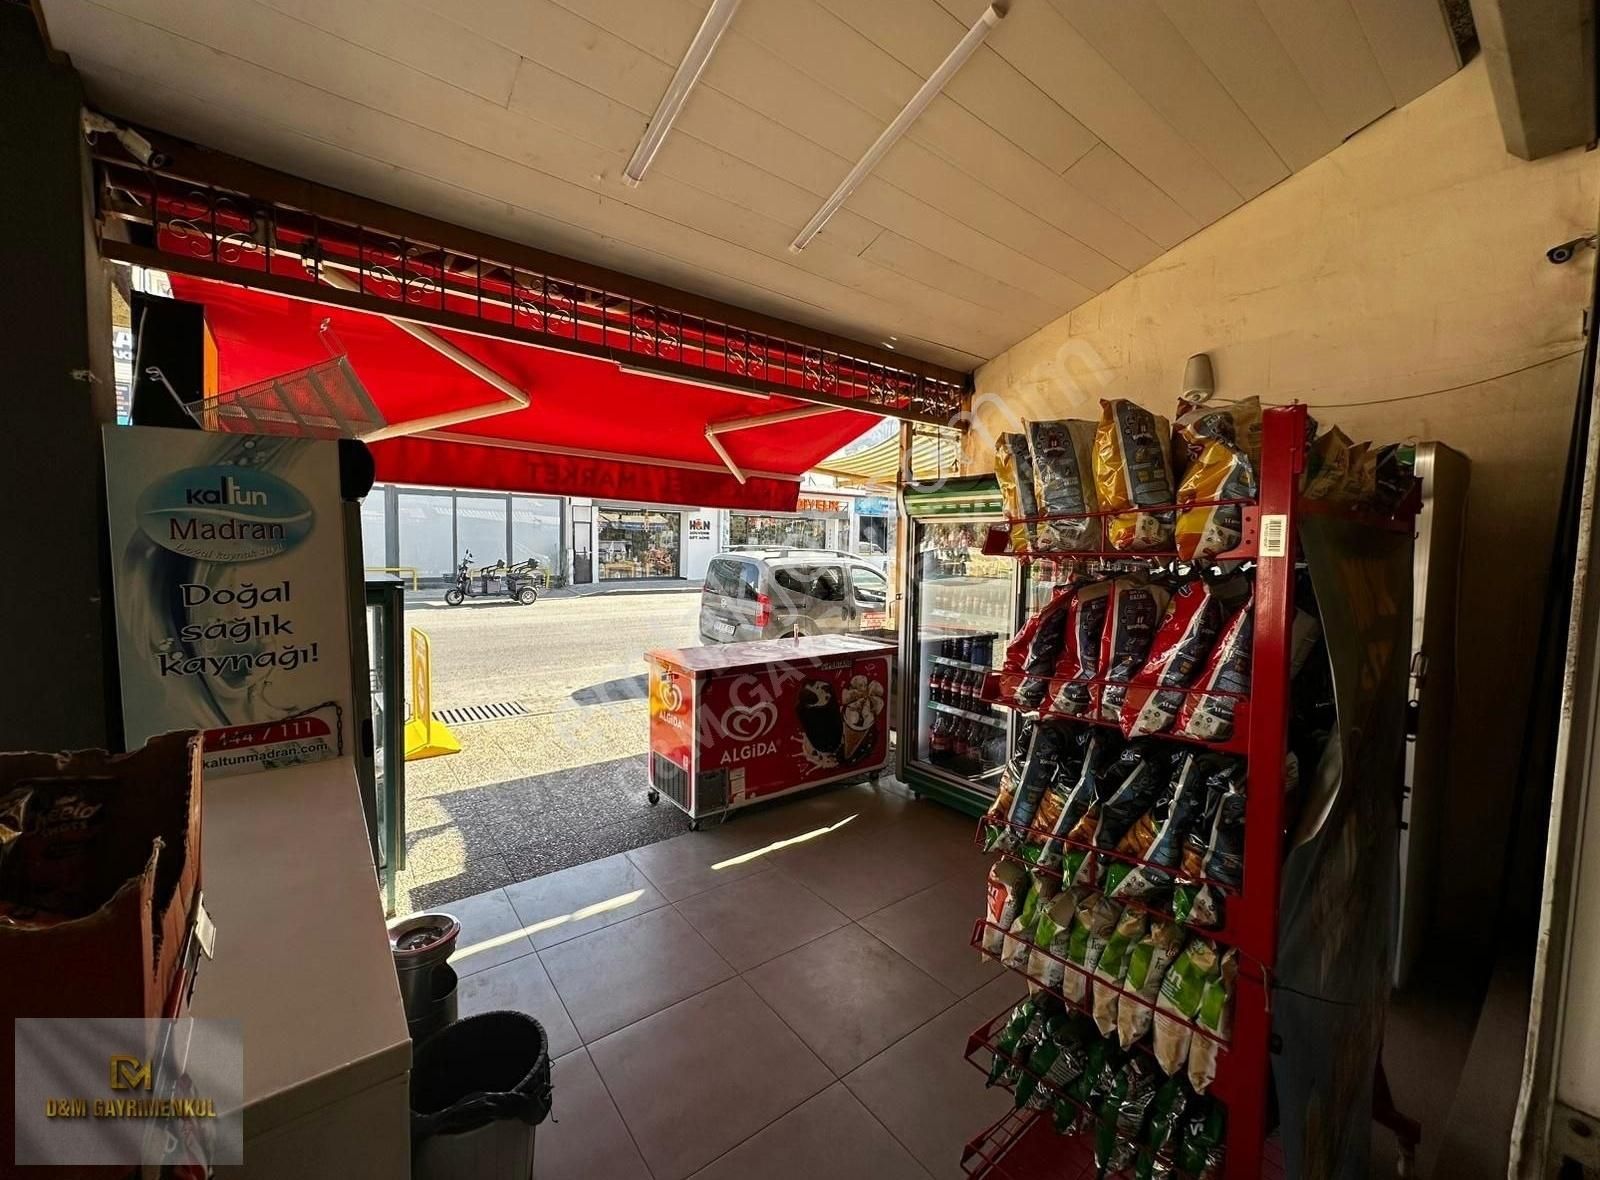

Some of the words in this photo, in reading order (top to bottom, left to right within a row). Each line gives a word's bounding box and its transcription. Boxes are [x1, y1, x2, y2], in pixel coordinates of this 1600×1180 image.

[168, 517, 287, 541] Madran
[181, 580, 291, 610] Doğal
[180, 616, 295, 644] sağlık
[159, 643, 320, 677] kaynağı!
